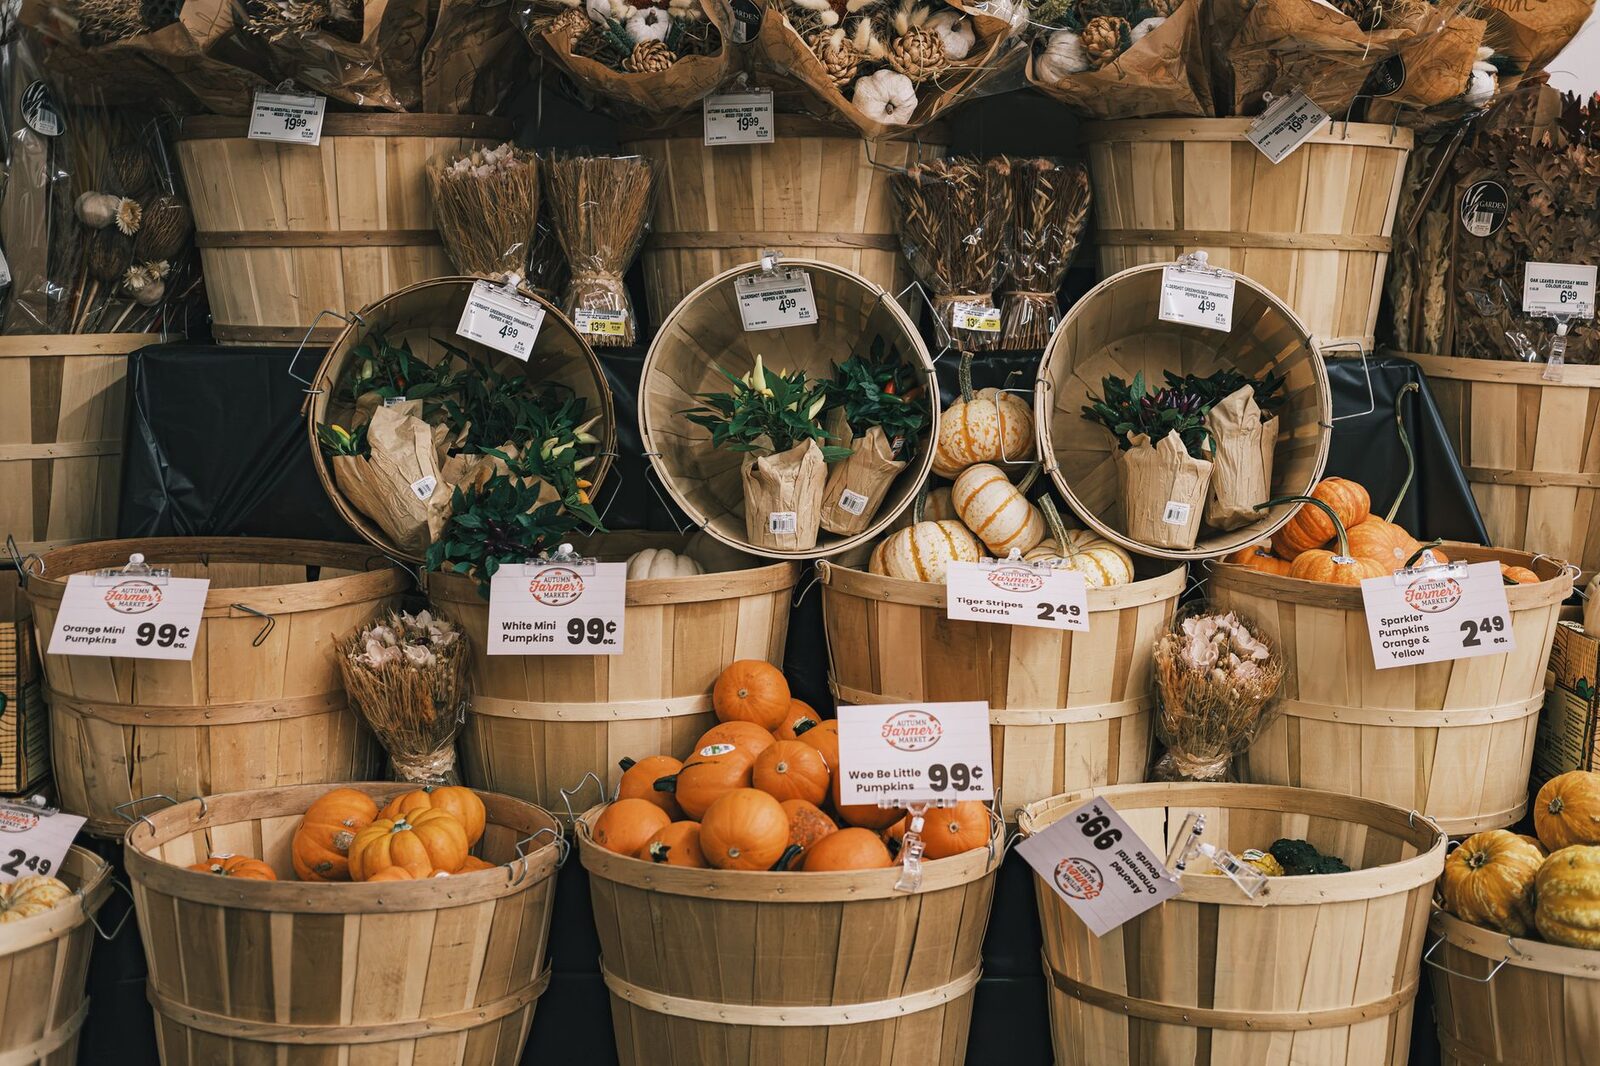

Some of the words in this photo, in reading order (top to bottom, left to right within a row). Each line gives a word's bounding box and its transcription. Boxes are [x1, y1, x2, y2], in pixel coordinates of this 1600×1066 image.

[1480, 200, 1505, 208] GARDEN
[530, 580, 584, 593] Farmer's
[1418, 582, 1446, 591] AUTUMN
[104, 590, 163, 602] Farmer's
[1405, 584, 1462, 602] Farmer's
[956, 597, 984, 606] Tiger
[986, 599, 1023, 609] Stripes
[1422, 597, 1448, 606] MARKET
[971, 606, 1010, 615] Gourds
[502, 621, 532, 630] White
[534, 621, 556, 630] Mini
[1381, 614, 1423, 628] Sparkler
[63, 625, 100, 634] Orange
[103, 624, 125, 634] Mini
[1379, 624, 1429, 638] Pumpkins
[65, 635, 116, 645] Pumpkins
[502, 634, 554, 645] Pumpkins
[1382, 638, 1420, 648] Orange
[1494, 636, 1508, 644] ea.
[1391, 648, 1425, 659] Yellow
[881, 724, 943, 738] Farmer's
[849, 771, 874, 779] Wee
[877, 769, 890, 778] Be
[894, 768, 921, 778] Little
[856, 782, 914, 794] Pumpkins
[1093, 805, 1103, 815] ea.
[1135, 851, 1160, 880] Gourds
[1077, 865, 1096, 883] MARKET
[1110, 861, 1142, 894] Assorted
[1115, 850, 1157, 894] Ornamental
[1060, 858, 1100, 900] Farmer's
[1062, 873, 1082, 893] AUTUMN
